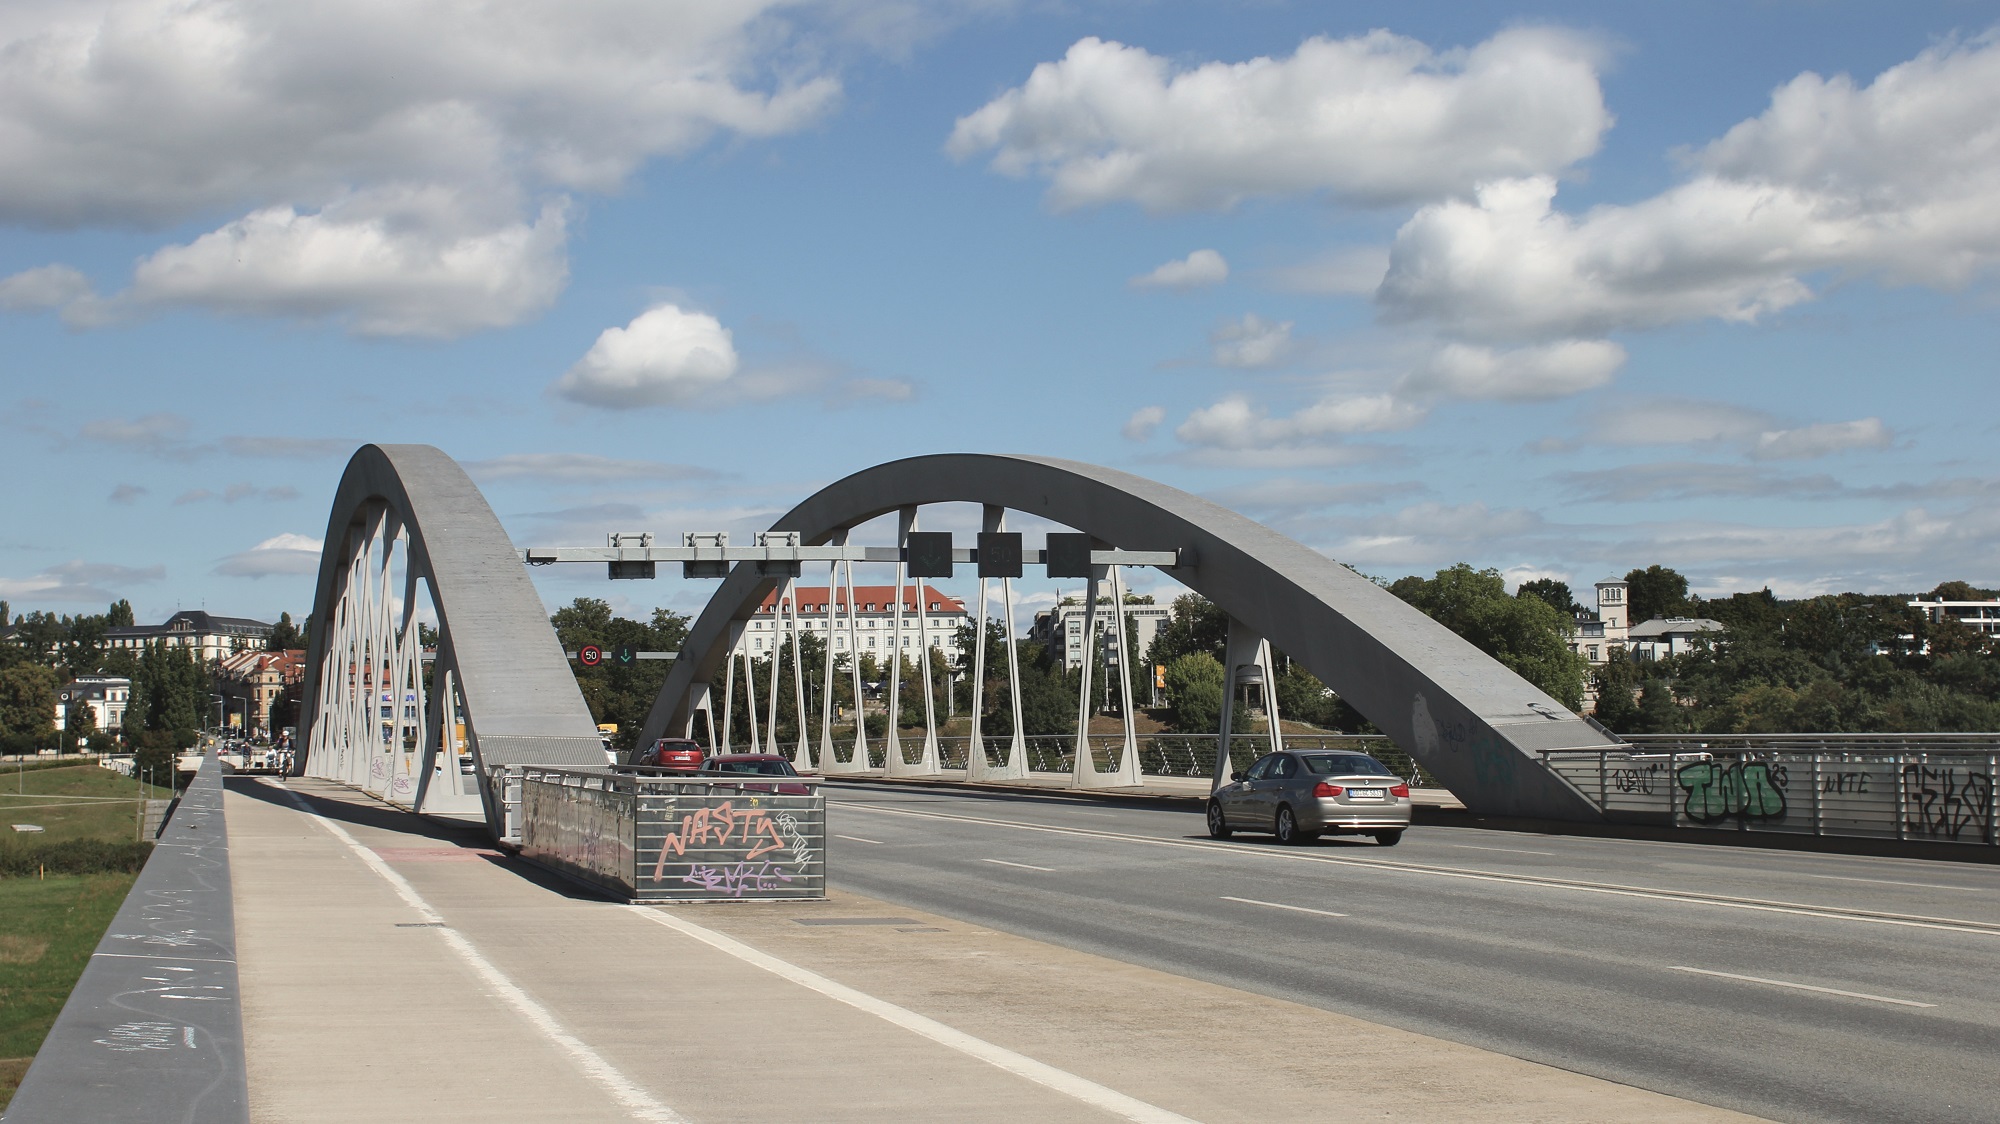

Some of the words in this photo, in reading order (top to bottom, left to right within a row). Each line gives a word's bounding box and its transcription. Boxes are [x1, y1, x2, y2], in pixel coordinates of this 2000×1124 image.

[585, 651, 597, 660] 50
[1677, 760, 1787, 825] TWA
[653, 801, 785, 881] NASTY
